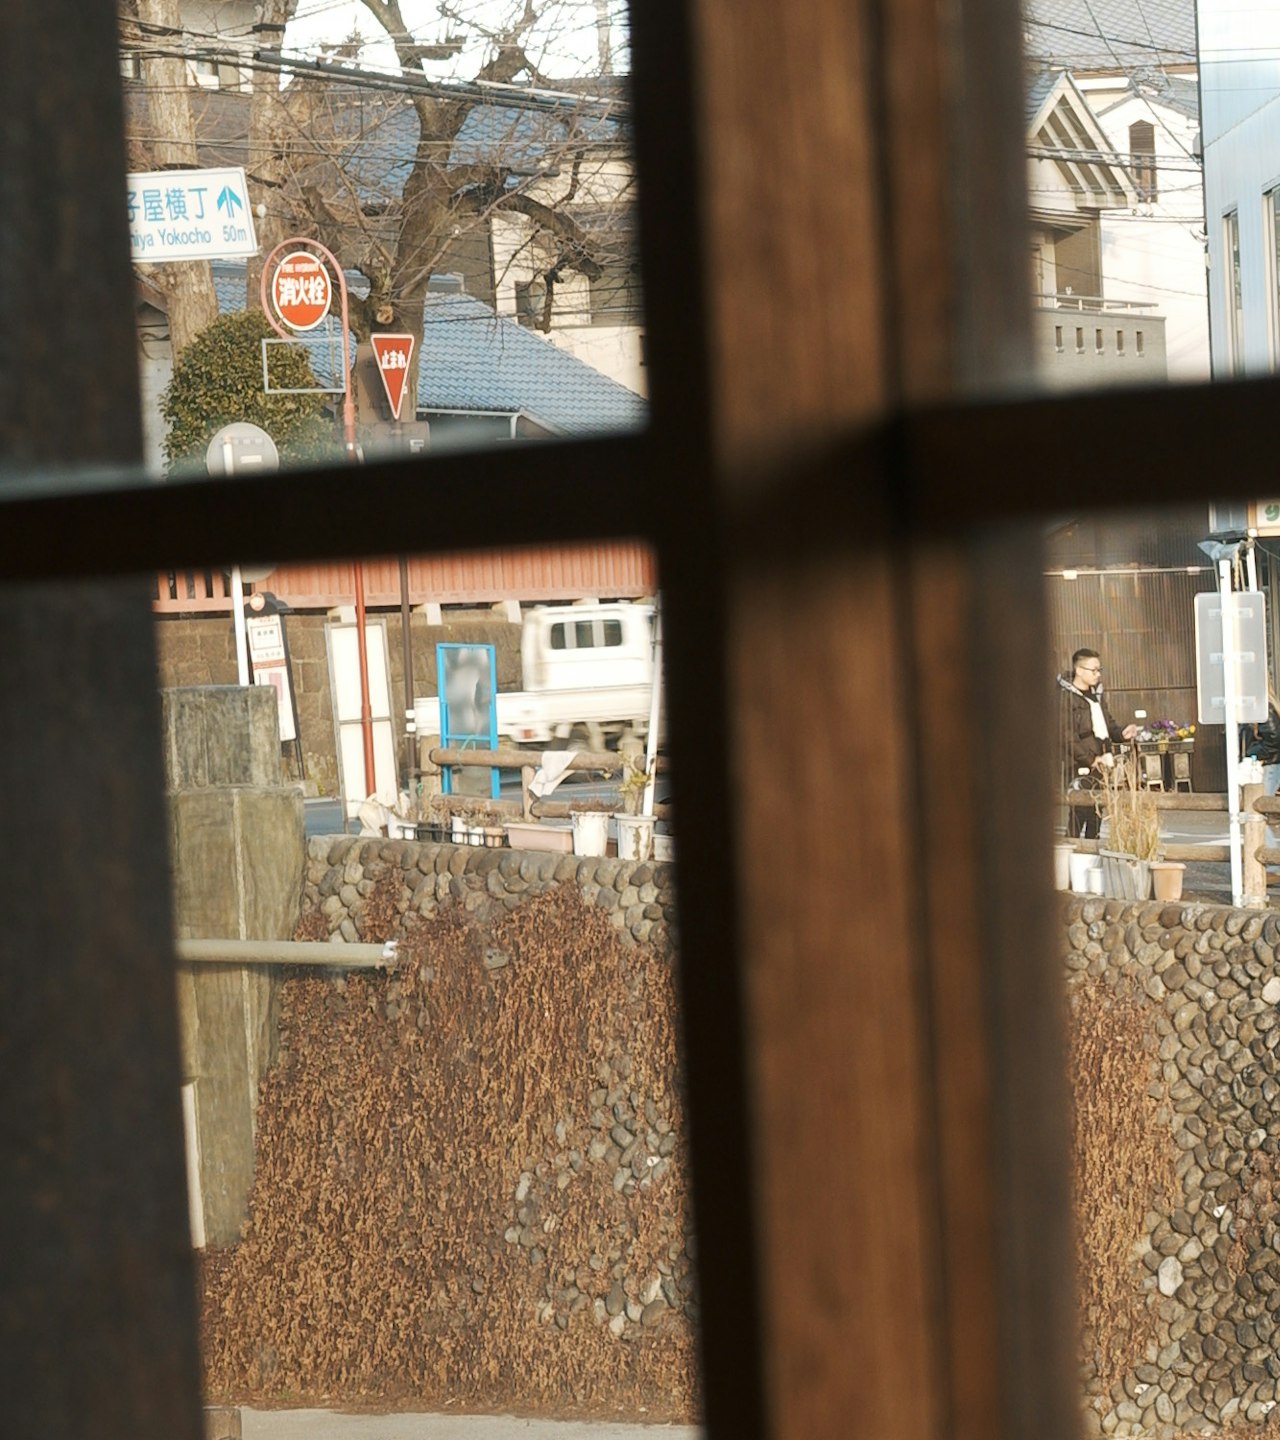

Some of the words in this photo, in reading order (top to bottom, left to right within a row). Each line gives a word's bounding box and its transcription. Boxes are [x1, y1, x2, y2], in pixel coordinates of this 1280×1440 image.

[157, 227, 211, 245] Yokocho
[222, 225, 247, 242] 50m
[279, 276, 326, 306] 消火栓
[382, 349, 407, 369] 止まれ
